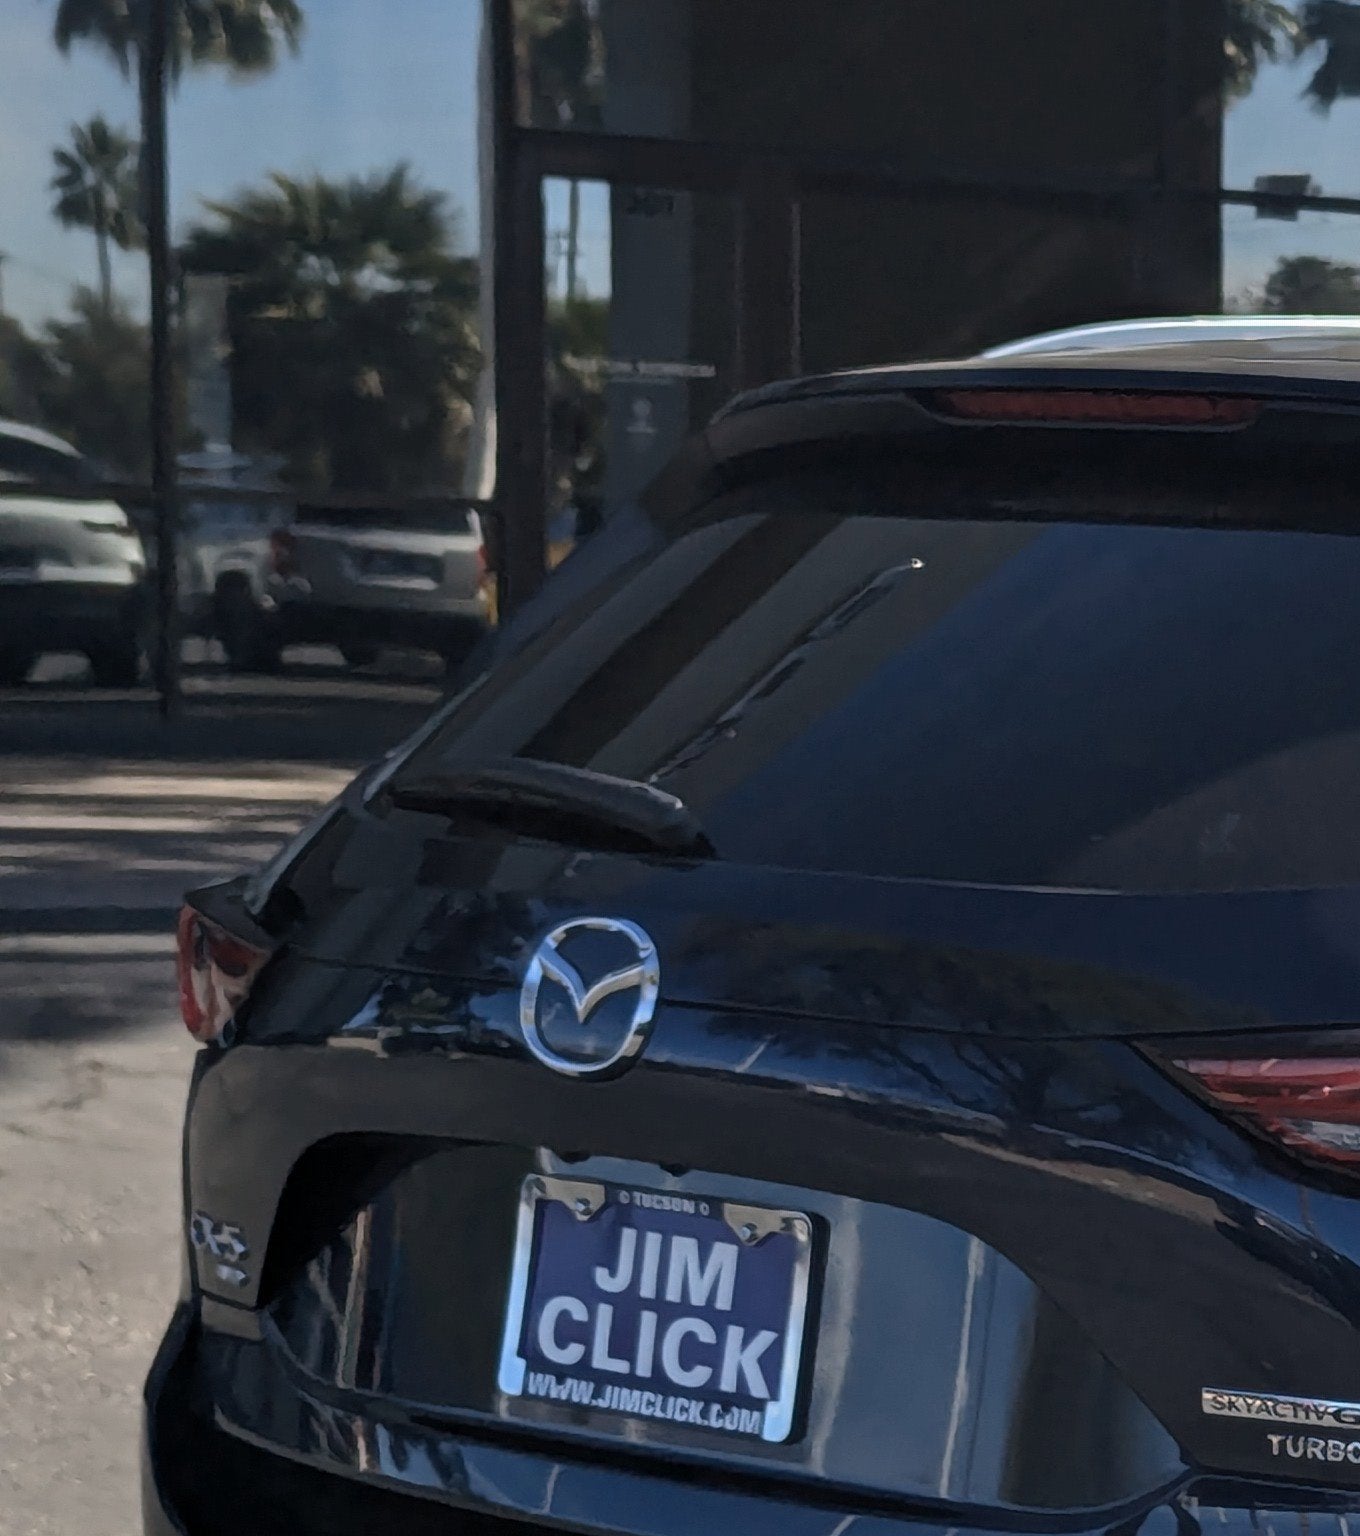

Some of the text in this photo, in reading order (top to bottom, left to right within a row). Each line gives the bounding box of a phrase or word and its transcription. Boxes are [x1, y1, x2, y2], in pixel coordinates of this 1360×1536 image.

[632, 1191, 696, 1214] TUCSON
[594, 1227, 739, 1311] JIM
[537, 1296, 779, 1400] CLICK
[527, 1372, 762, 1435] WWW.JIMCLICK.COM
